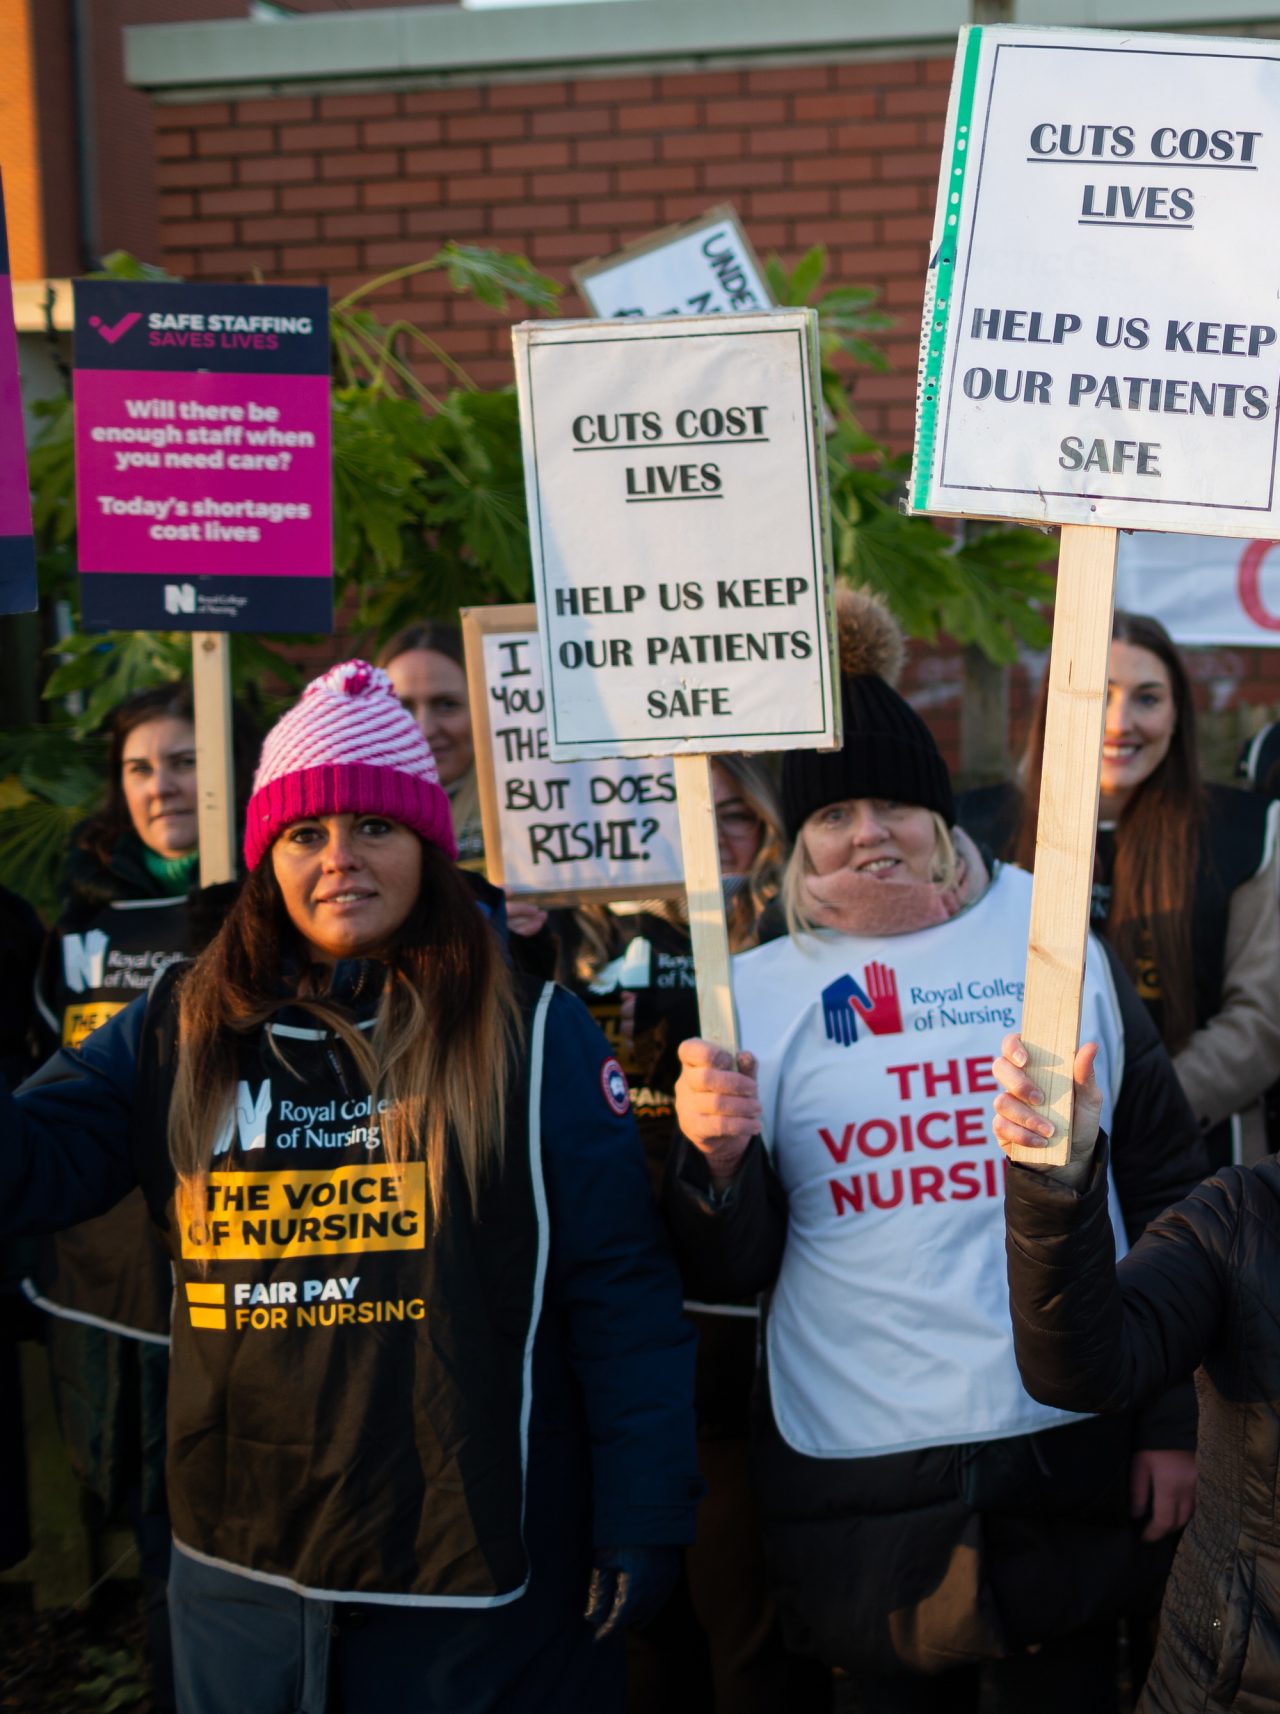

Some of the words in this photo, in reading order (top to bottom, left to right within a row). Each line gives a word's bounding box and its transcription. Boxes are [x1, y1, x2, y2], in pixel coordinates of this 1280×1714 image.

[1030, 123, 1135, 157] CUTS
[1150, 127, 1263, 163] COST
[1080, 184, 1195, 221] LIVES
[702, 231, 760, 311] UNDE
[148, 313, 205, 331] SAFE
[207, 315, 314, 334] STAFFING
[148, 331, 216, 348] SAVES
[221, 334, 279, 350] LIVES
[970, 307, 1081, 344] HELP
[1095, 315, 1150, 349] US
[1165, 319, 1277, 357] KEEP
[125, 399, 175, 419] Will
[179, 401, 244, 422] there
[248, 402, 280, 422] be
[962, 366, 1053, 404] OUR
[1068, 372, 1270, 420] PATIENTS
[91, 425, 183, 448] enough
[186, 425, 244, 446] staff
[246, 428, 316, 447] when
[572, 411, 663, 443] CUTS
[675, 405, 769, 438] COST
[115, 453, 161, 471] you
[164, 450, 225, 470] need
[227, 451, 293, 471] care?
[1058, 435, 1162, 477] SAFE
[625, 463, 722, 495] LIVES
[98, 495, 189, 520] Today's
[192, 497, 311, 522] shortages
[150, 522, 203, 541] cost
[204, 520, 261, 542] lives
[555, 584, 646, 616] HELP
[659, 581, 705, 612] US
[716, 576, 810, 609] KEEP
[498, 640, 531, 678] I
[558, 638, 633, 669] OUR
[646, 630, 813, 666] PATIENTS
[647, 687, 733, 719] SAFE
[505, 778, 570, 811] BUT
[590, 771, 677, 806] DOES
[528, 817, 660, 865] RISHI?
[910, 982, 964, 1009] Royal
[967, 978, 1025, 1003] Colleg
[914, 1010, 935, 1032] of
[940, 1005, 1016, 1028] Nursing
[886, 1055, 998, 1101] THE
[279, 1100, 336, 1129] Royal
[276, 1128, 301, 1149] of
[305, 1125, 380, 1150] Nursing
[817, 1107, 988, 1165] VOICE
[205, 1185, 270, 1212] THE
[283, 1176, 402, 1210] VOICE
[828, 1158, 1007, 1217] NURSI
[242, 1210, 418, 1246] NURSING
[234, 1281, 297, 1306] FAIR
[303, 1276, 360, 1301] PAY
[235, 1307, 287, 1330] FOR
[296, 1298, 425, 1327] NURSING
